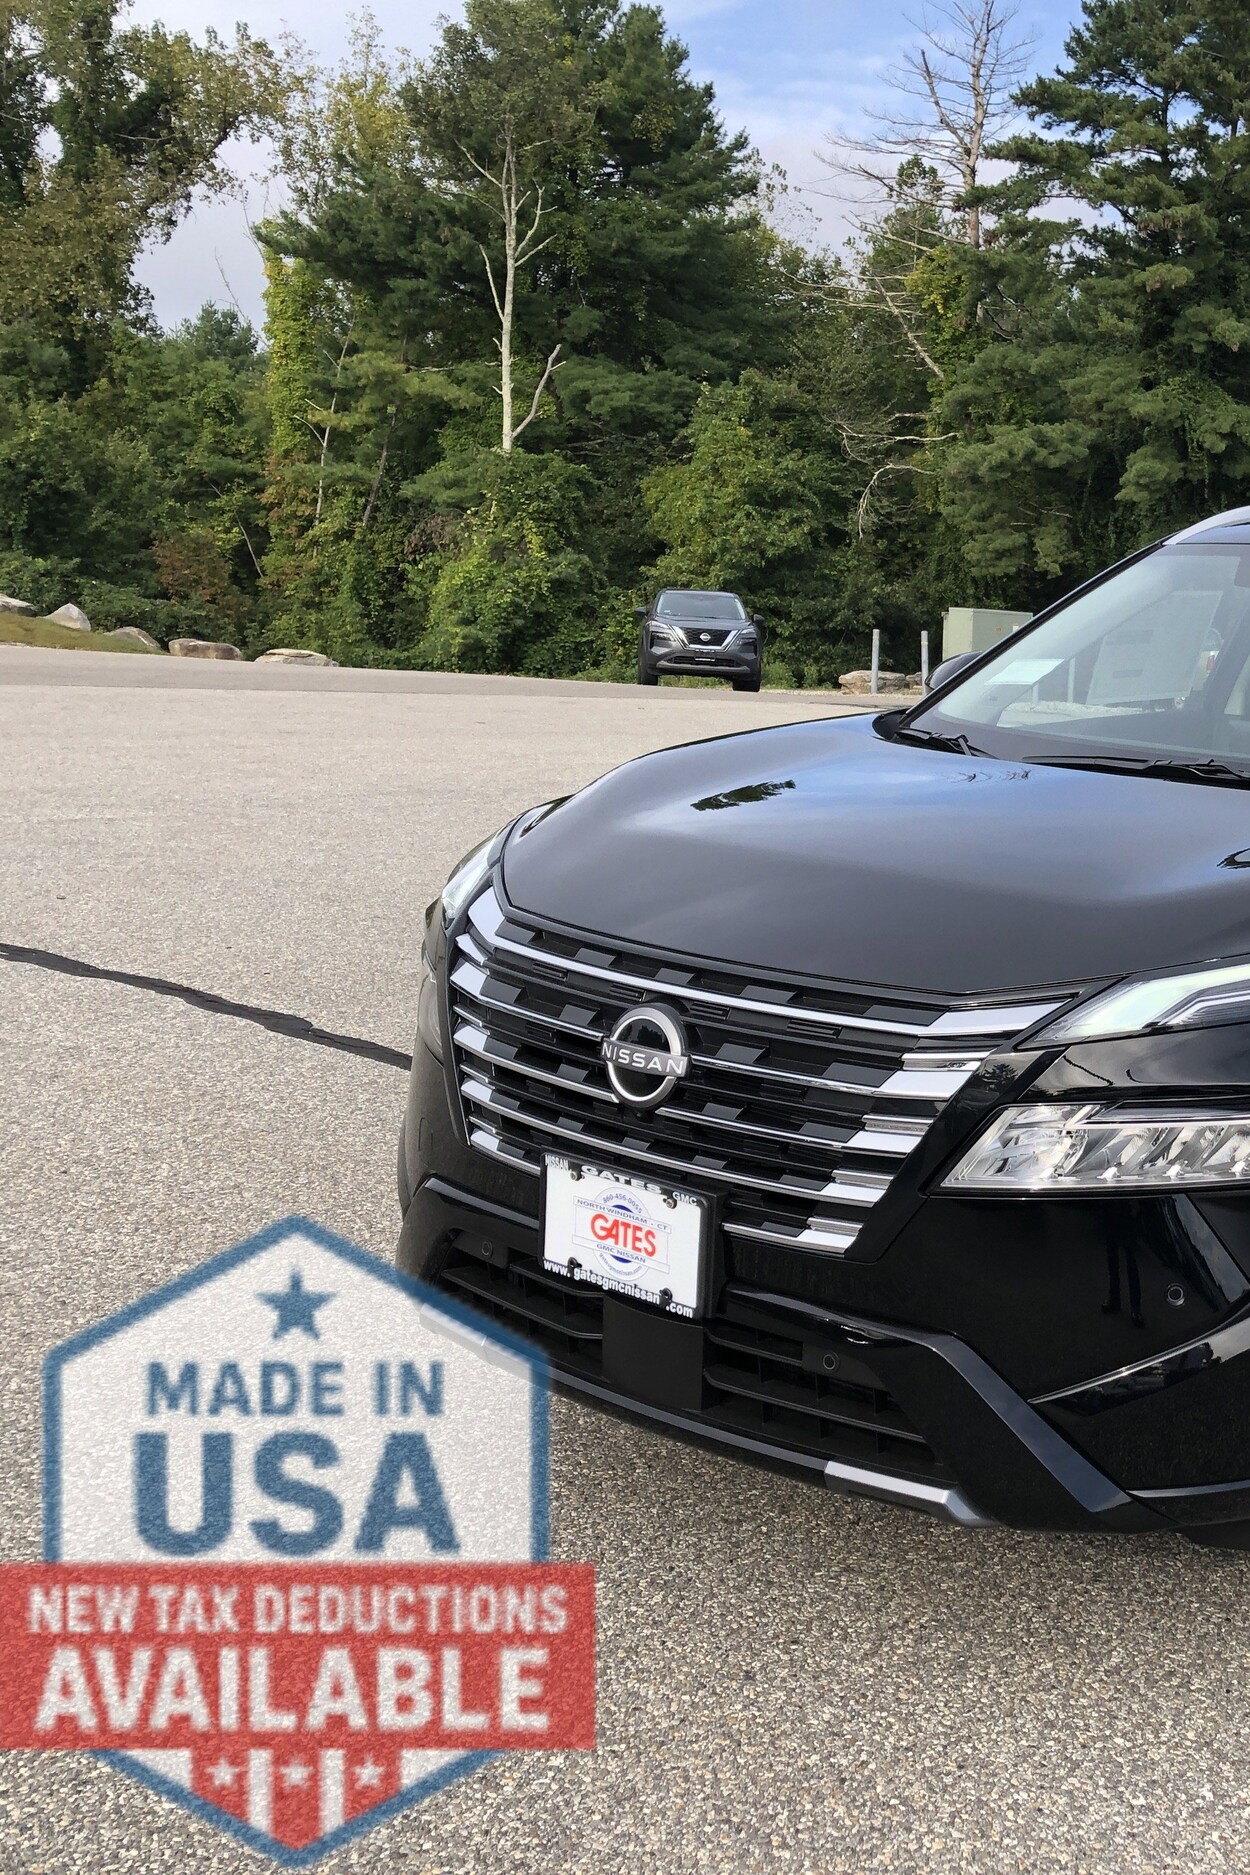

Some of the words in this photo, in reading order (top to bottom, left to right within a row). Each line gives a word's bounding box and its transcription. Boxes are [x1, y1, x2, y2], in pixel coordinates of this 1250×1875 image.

[602, 1042, 683, 1074] NISSAN
[545, 1154, 569, 1171] NISSAN
[581, 1165, 661, 1194] GATES
[672, 1191, 697, 1206] GMC
[577, 1199, 606, 1211] NORTH
[607, 1206, 648, 1224] WINDHAM
[657, 1223, 668, 1231] CT
[590, 1213, 656, 1257] GATES
[596, 1243, 615, 1253] GMC
[616, 1250, 646, 1264] NISSAN
